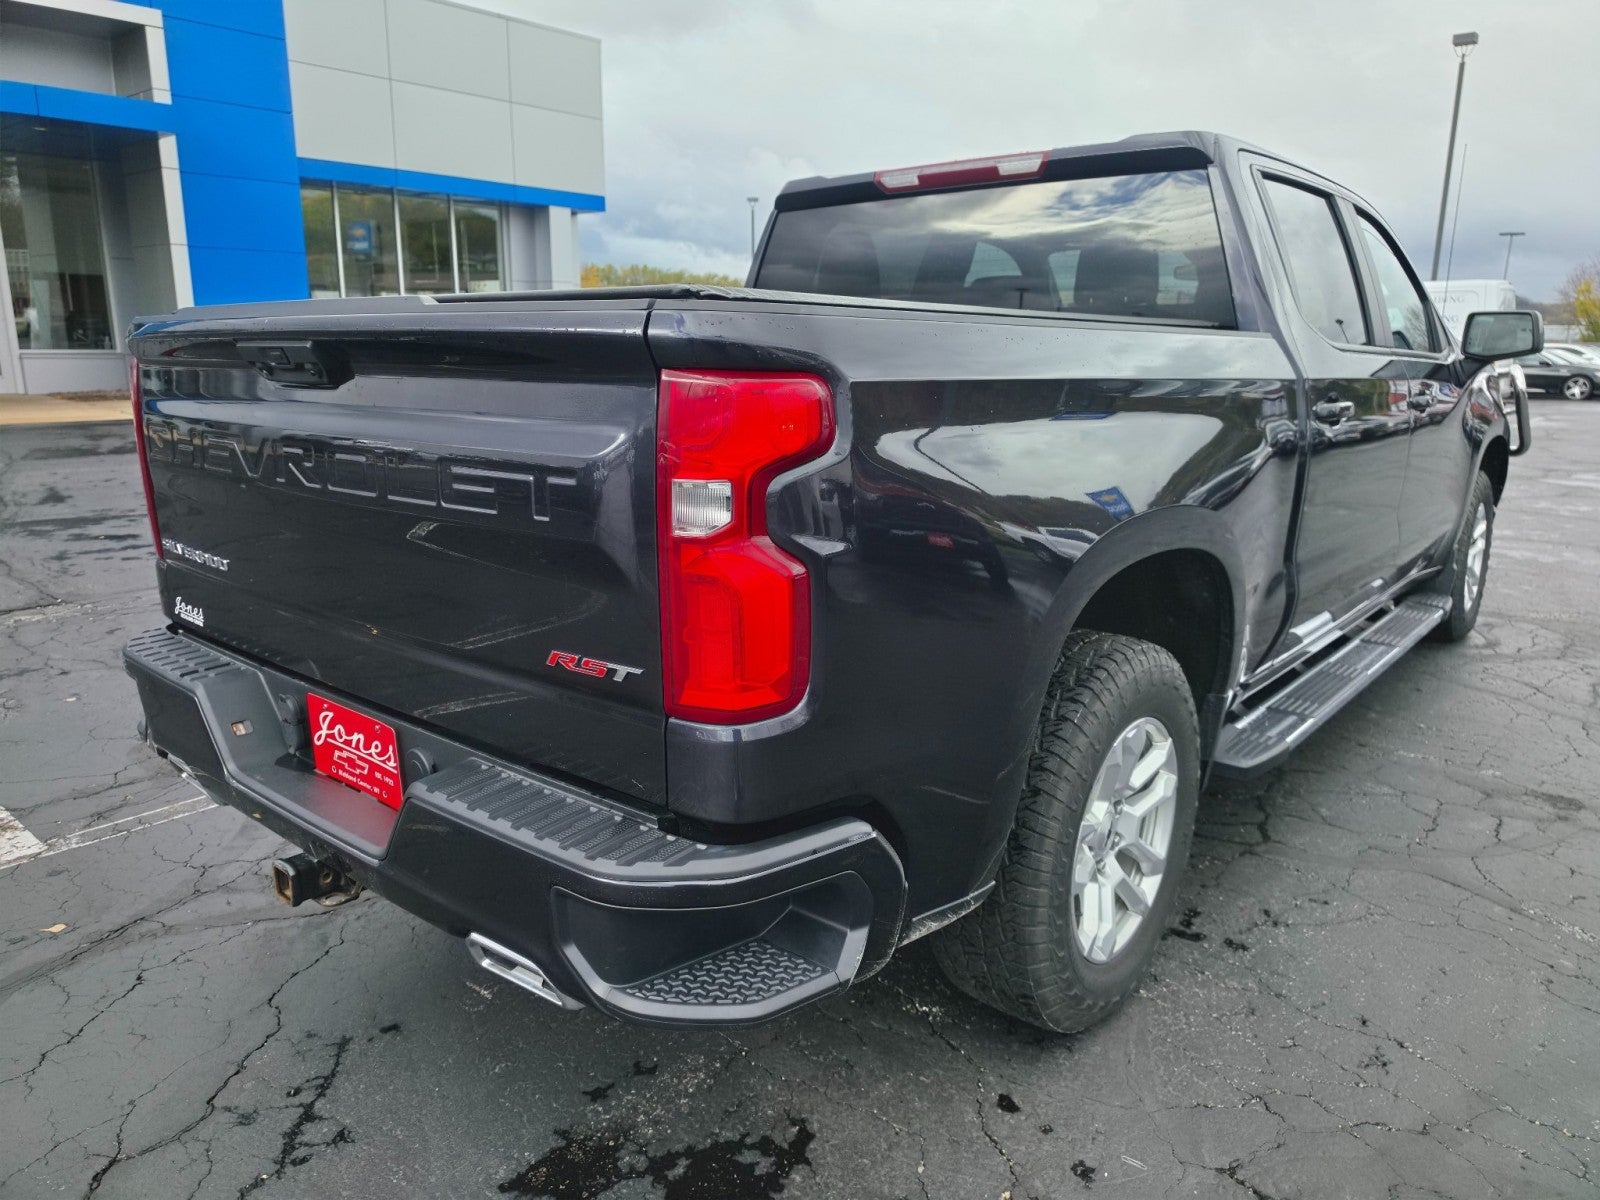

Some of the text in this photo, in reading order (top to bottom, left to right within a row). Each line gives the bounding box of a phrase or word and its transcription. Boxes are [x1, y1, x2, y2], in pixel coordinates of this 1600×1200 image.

[145, 416, 577, 522] CHEVROLET
[162, 538, 230, 571] SILVERADO
[175, 596, 204, 619] Jones
[546, 650, 645, 682] RST
[313, 711, 397, 767] Jones
